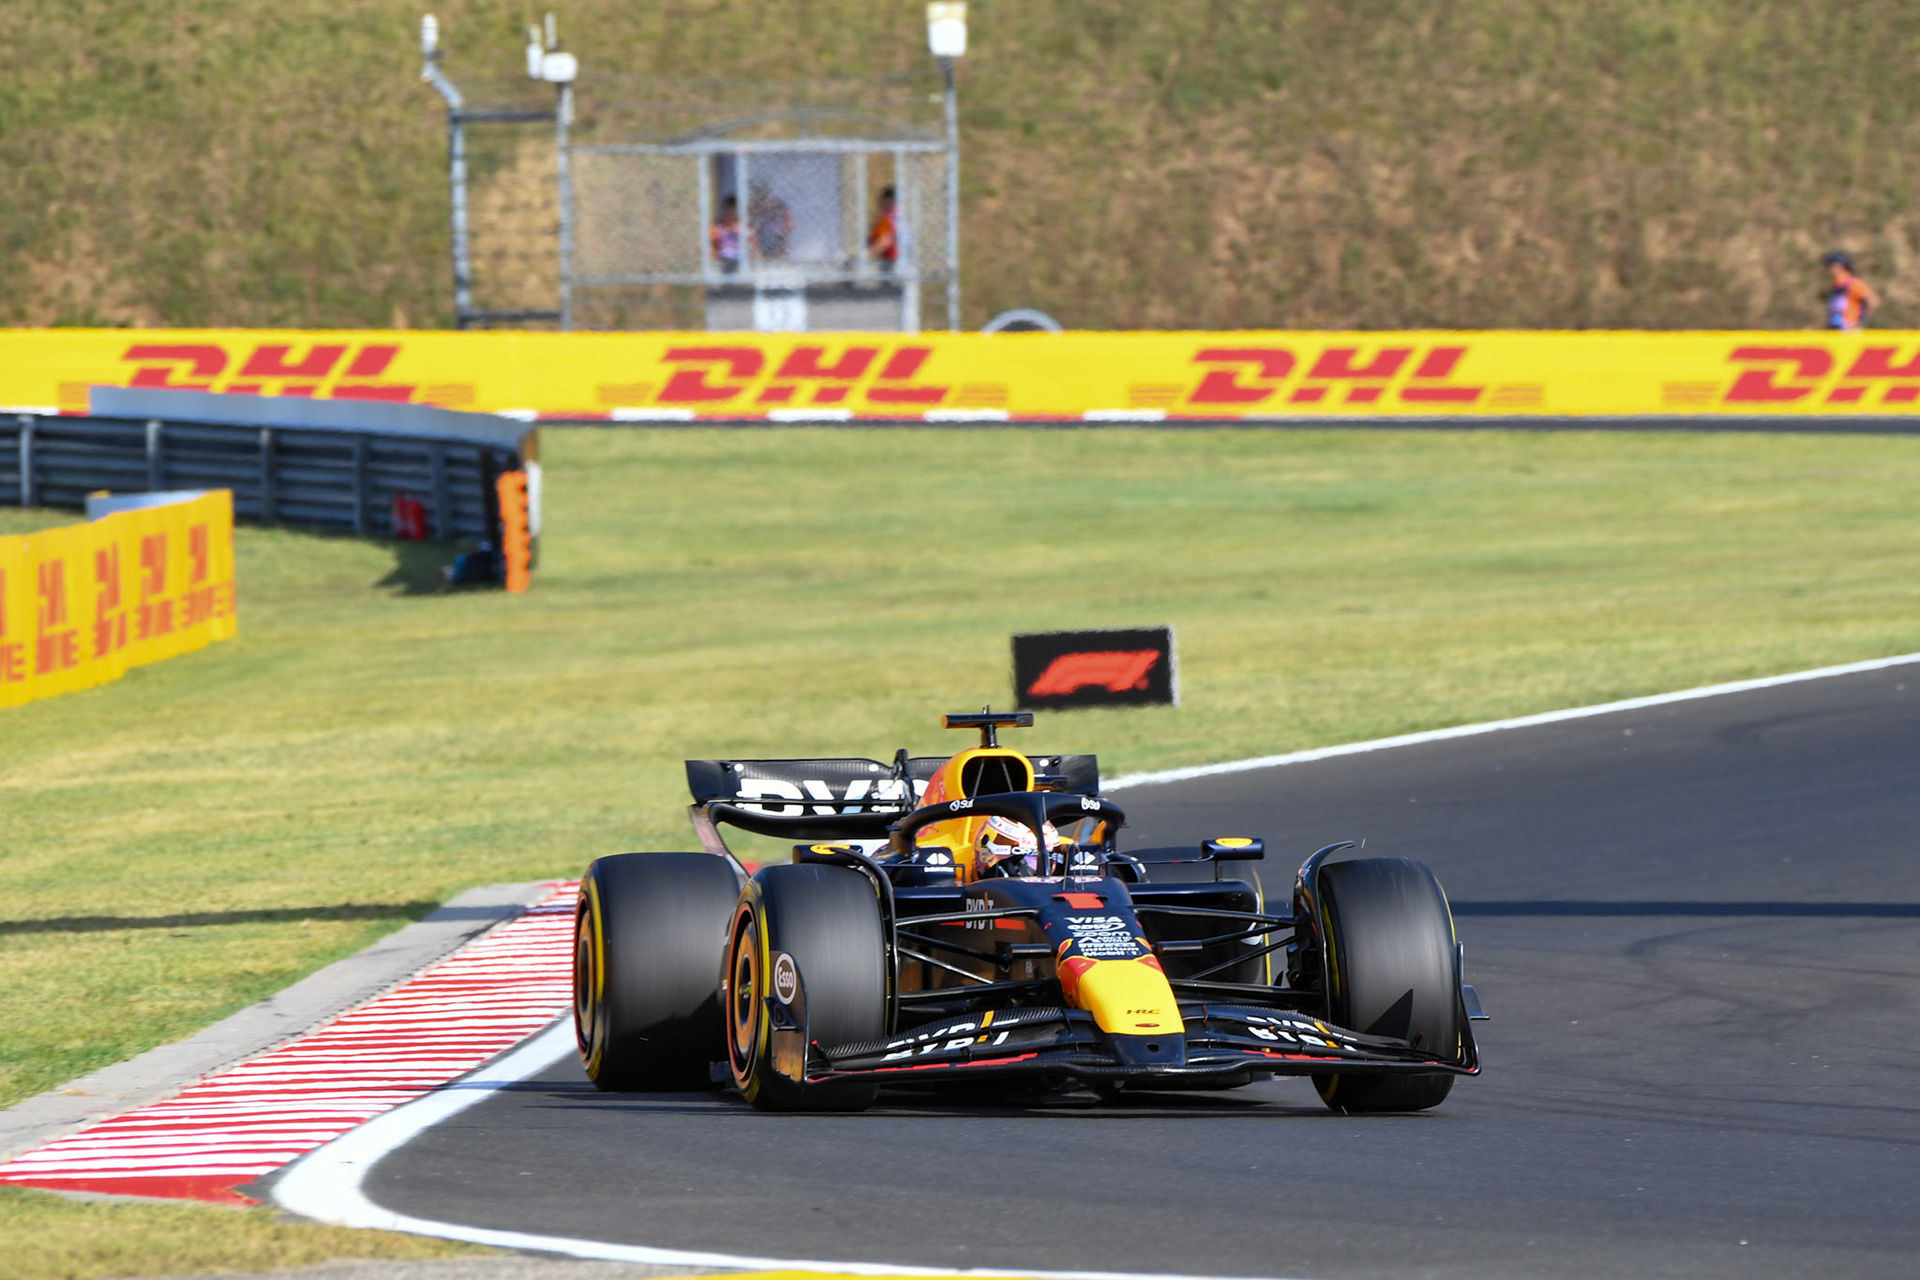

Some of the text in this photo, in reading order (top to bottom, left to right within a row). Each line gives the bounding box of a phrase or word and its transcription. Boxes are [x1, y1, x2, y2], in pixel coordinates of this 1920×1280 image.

[121, 345, 418, 402] DHL
[656, 345, 949, 404] DHL
[1185, 345, 1485, 404] DHL
[1723, 345, 1920, 404] DH
[1063, 916, 1123, 924] VISA
[778, 966, 793, 988] Esso
